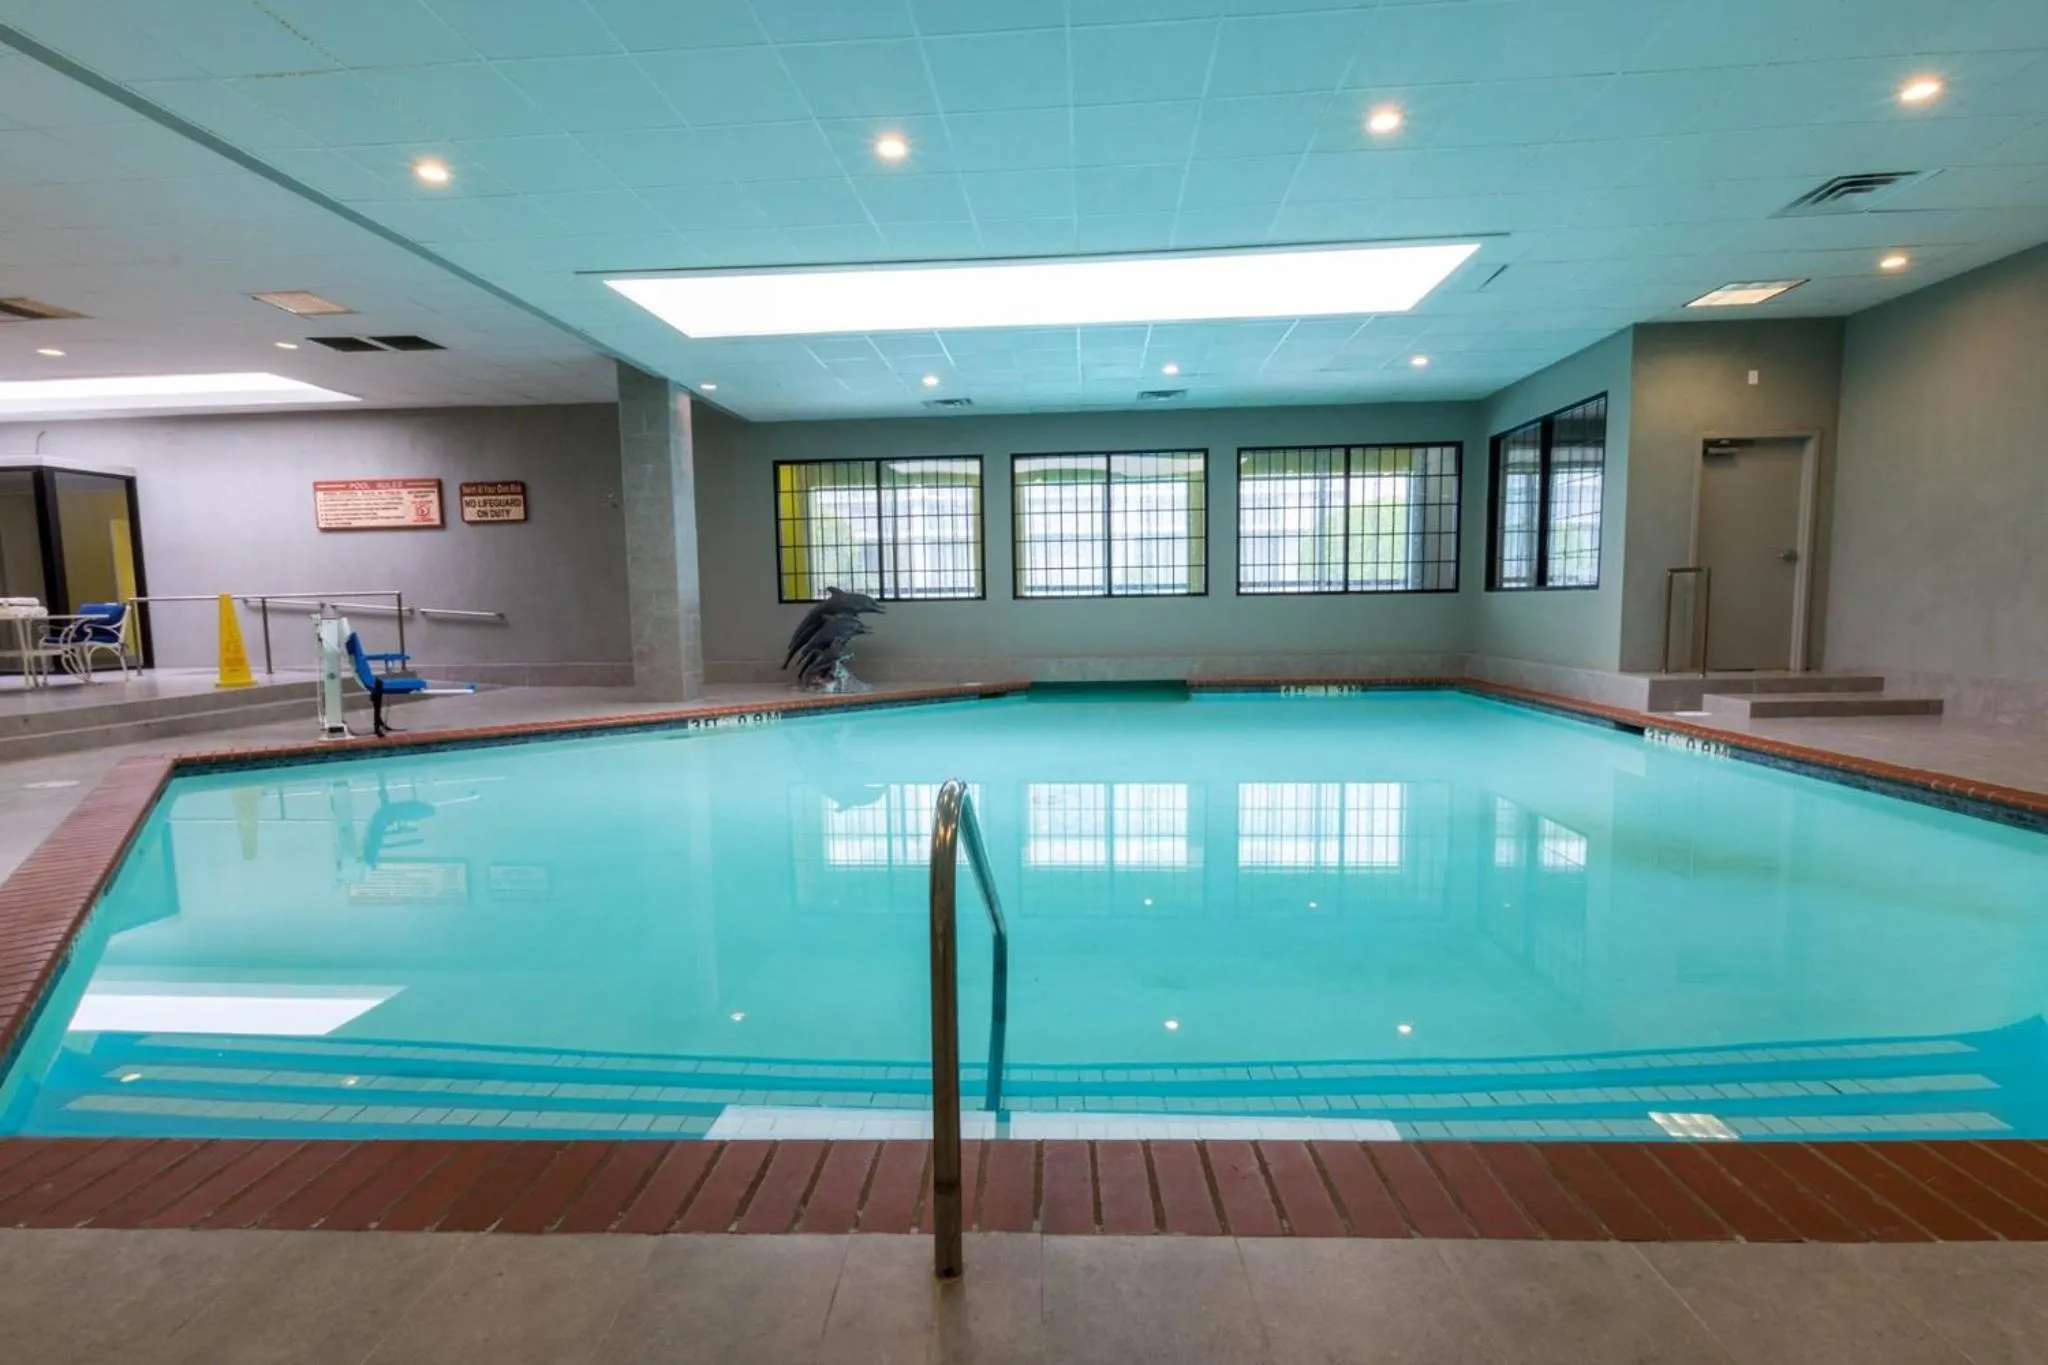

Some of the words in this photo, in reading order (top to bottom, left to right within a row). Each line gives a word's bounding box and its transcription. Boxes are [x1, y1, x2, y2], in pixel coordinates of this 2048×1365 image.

[464, 498, 476, 508] NO
[477, 497, 521, 508] LIFEGUARD
[477, 509, 490, 518] ON
[491, 508, 511, 518] DUTY
